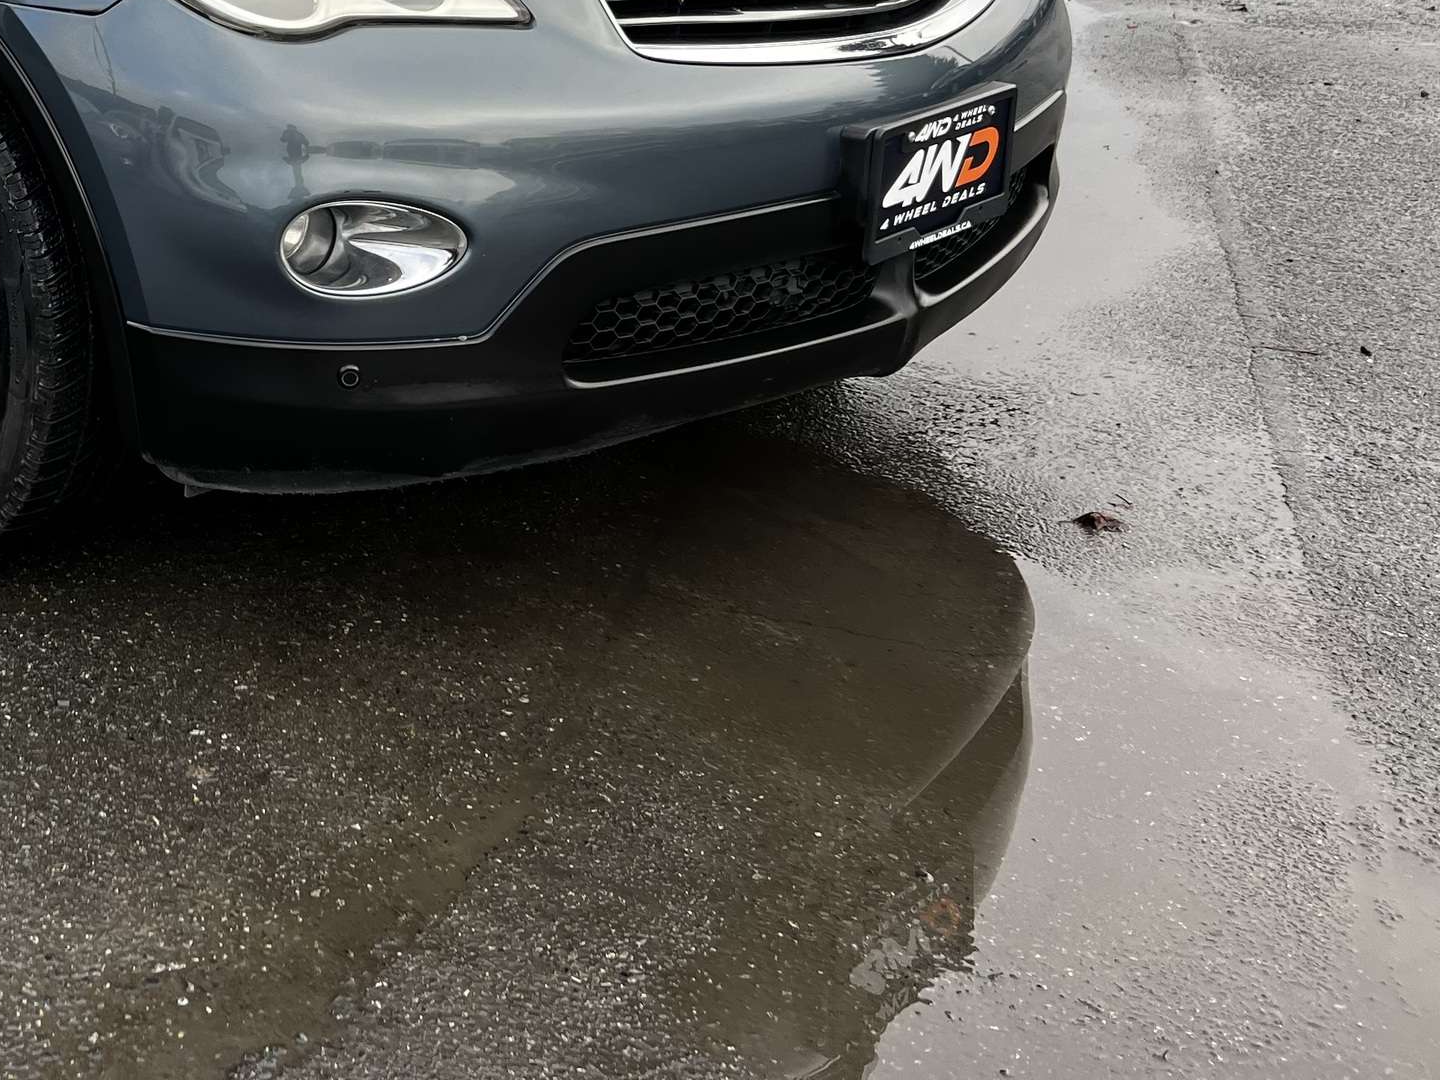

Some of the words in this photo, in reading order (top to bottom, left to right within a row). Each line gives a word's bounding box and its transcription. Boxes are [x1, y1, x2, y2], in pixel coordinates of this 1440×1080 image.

[914, 116, 952, 142] 4WD
[961, 104, 987, 120] WHEEL
[955, 114, 984, 131] DEALS
[882, 126, 1000, 208] 4WD
[879, 218, 890, 230] 4
[893, 200, 937, 226] WHEEL
[942, 182, 986, 208] DEALS
